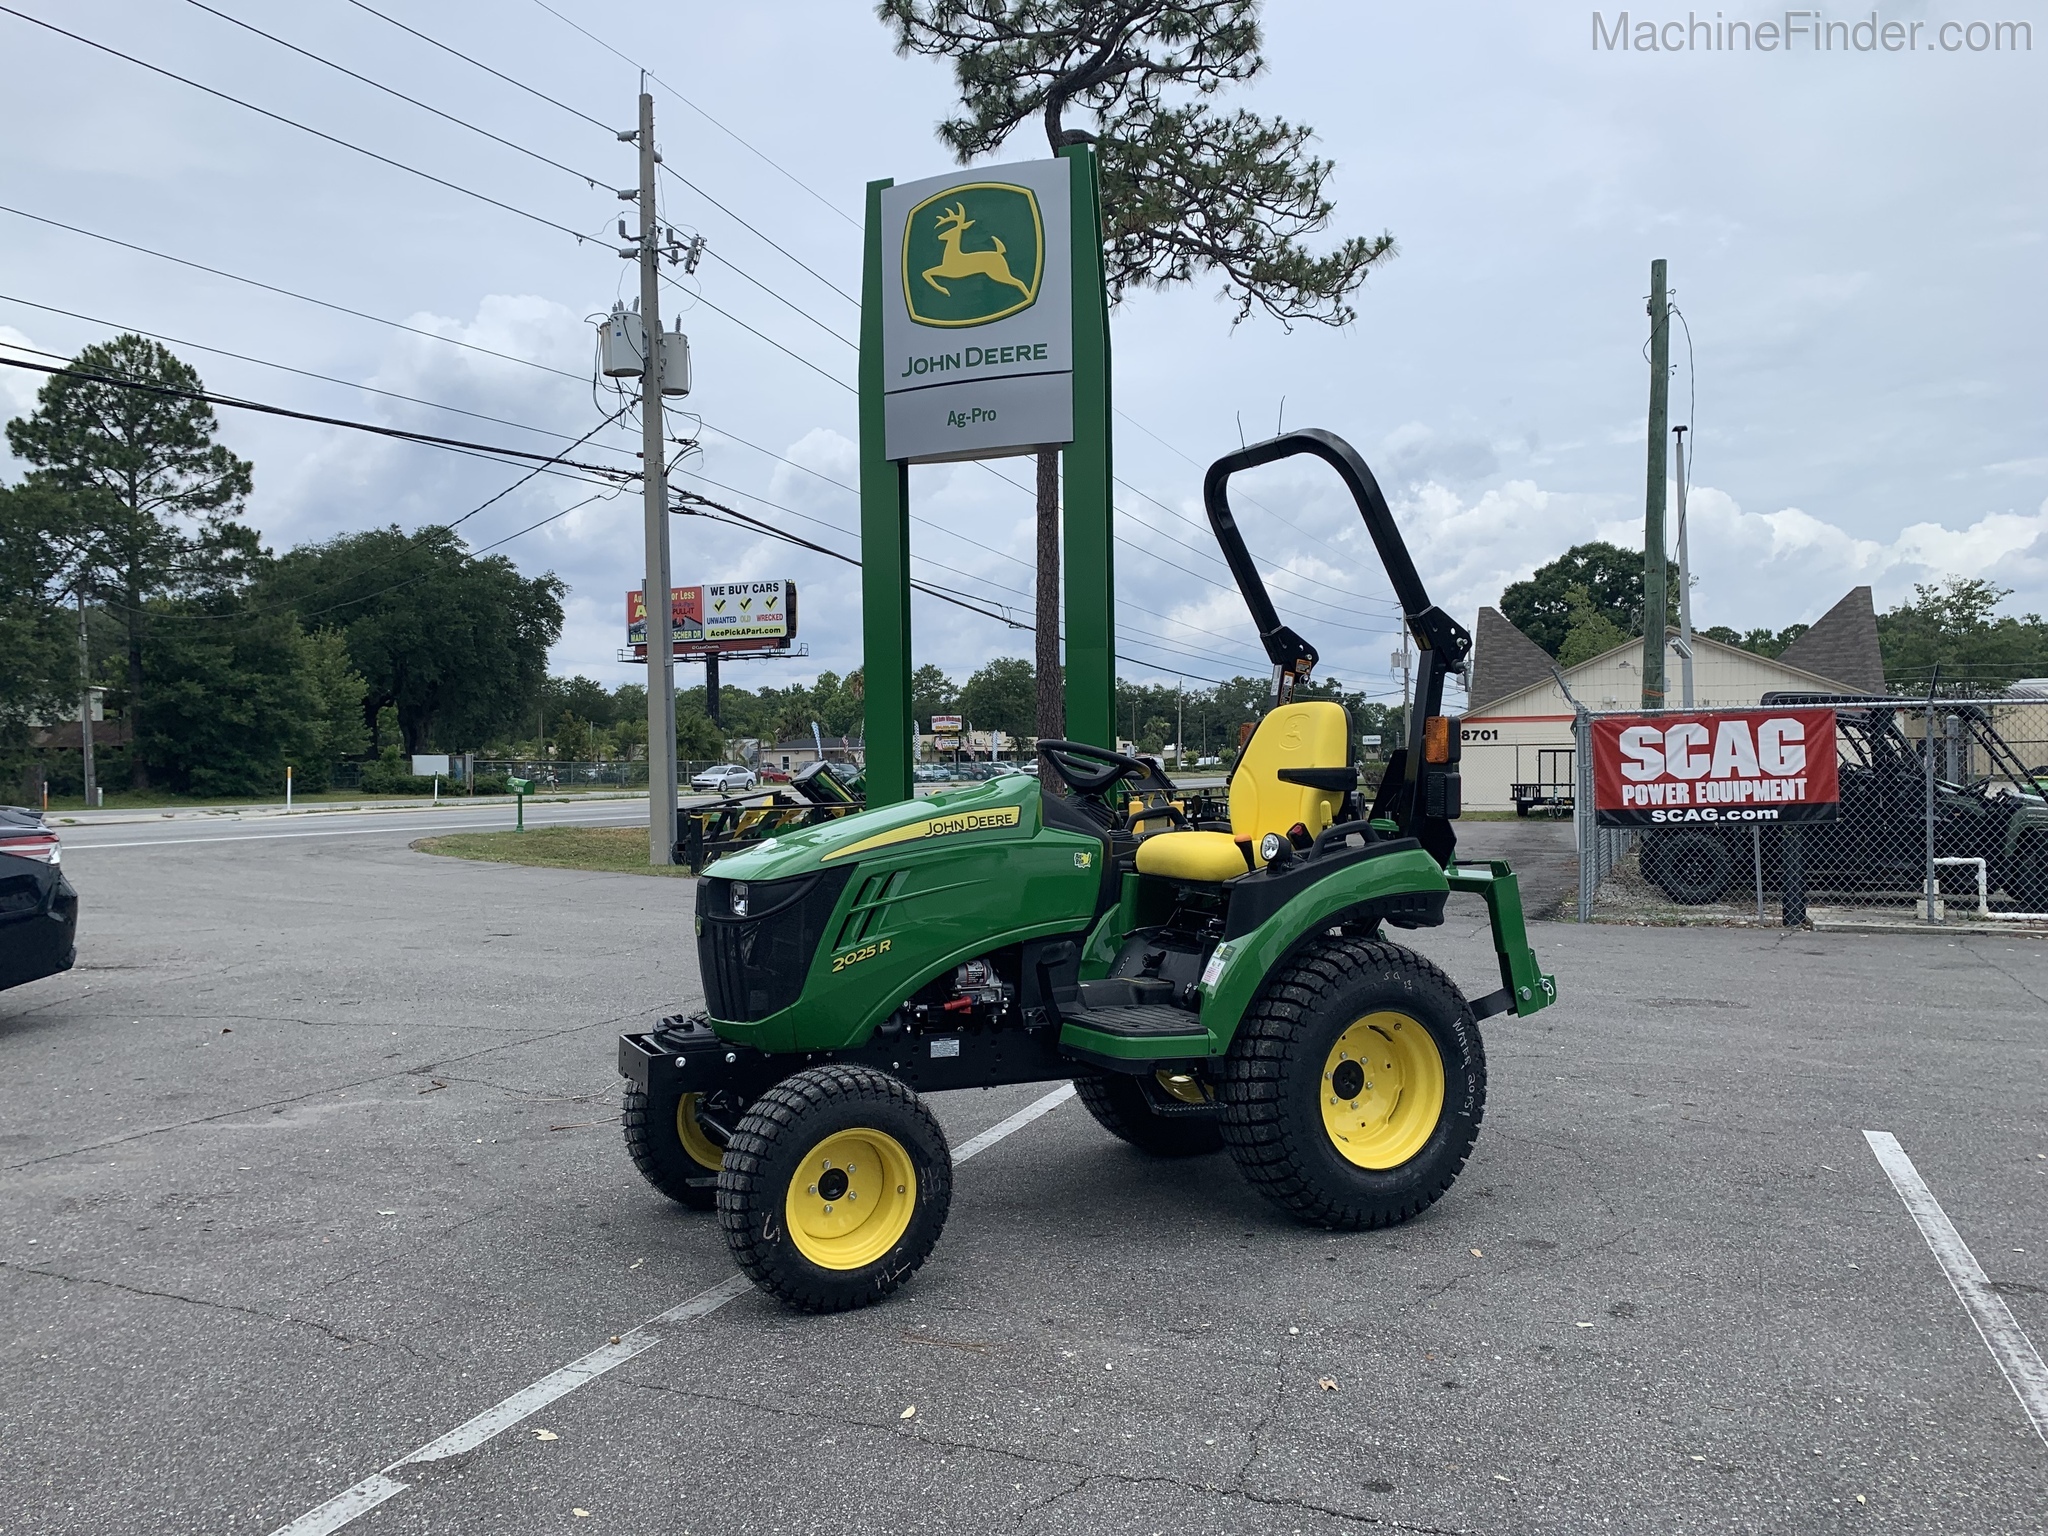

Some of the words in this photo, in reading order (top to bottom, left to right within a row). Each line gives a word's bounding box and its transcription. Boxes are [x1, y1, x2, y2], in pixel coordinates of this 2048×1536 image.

[901, 352, 961, 378] JOHN
[965, 343, 1048, 368] DEERE
[946, 407, 997, 428] Ag-Pro
[680, 590, 695, 600] Less
[710, 586, 725, 596] WE
[728, 584, 749, 595] BUY
[752, 582, 779, 593] CARS
[706, 616, 737, 625] UNWANTED
[740, 615, 751, 623] OLD
[756, 613, 784, 622] WRECKED
[710, 627, 781, 637] AcePickAPart.com
[1461, 729, 1498, 741] 8701
[1619, 717, 1806, 782] SCAG
[1622, 782, 1690, 806] POWER
[1695, 777, 1808, 803] EQUIPMENT
[1651, 807, 1779, 823] SCAG.com
[925, 819, 965, 836] JOHN
[967, 813, 1013, 829] DEERE
